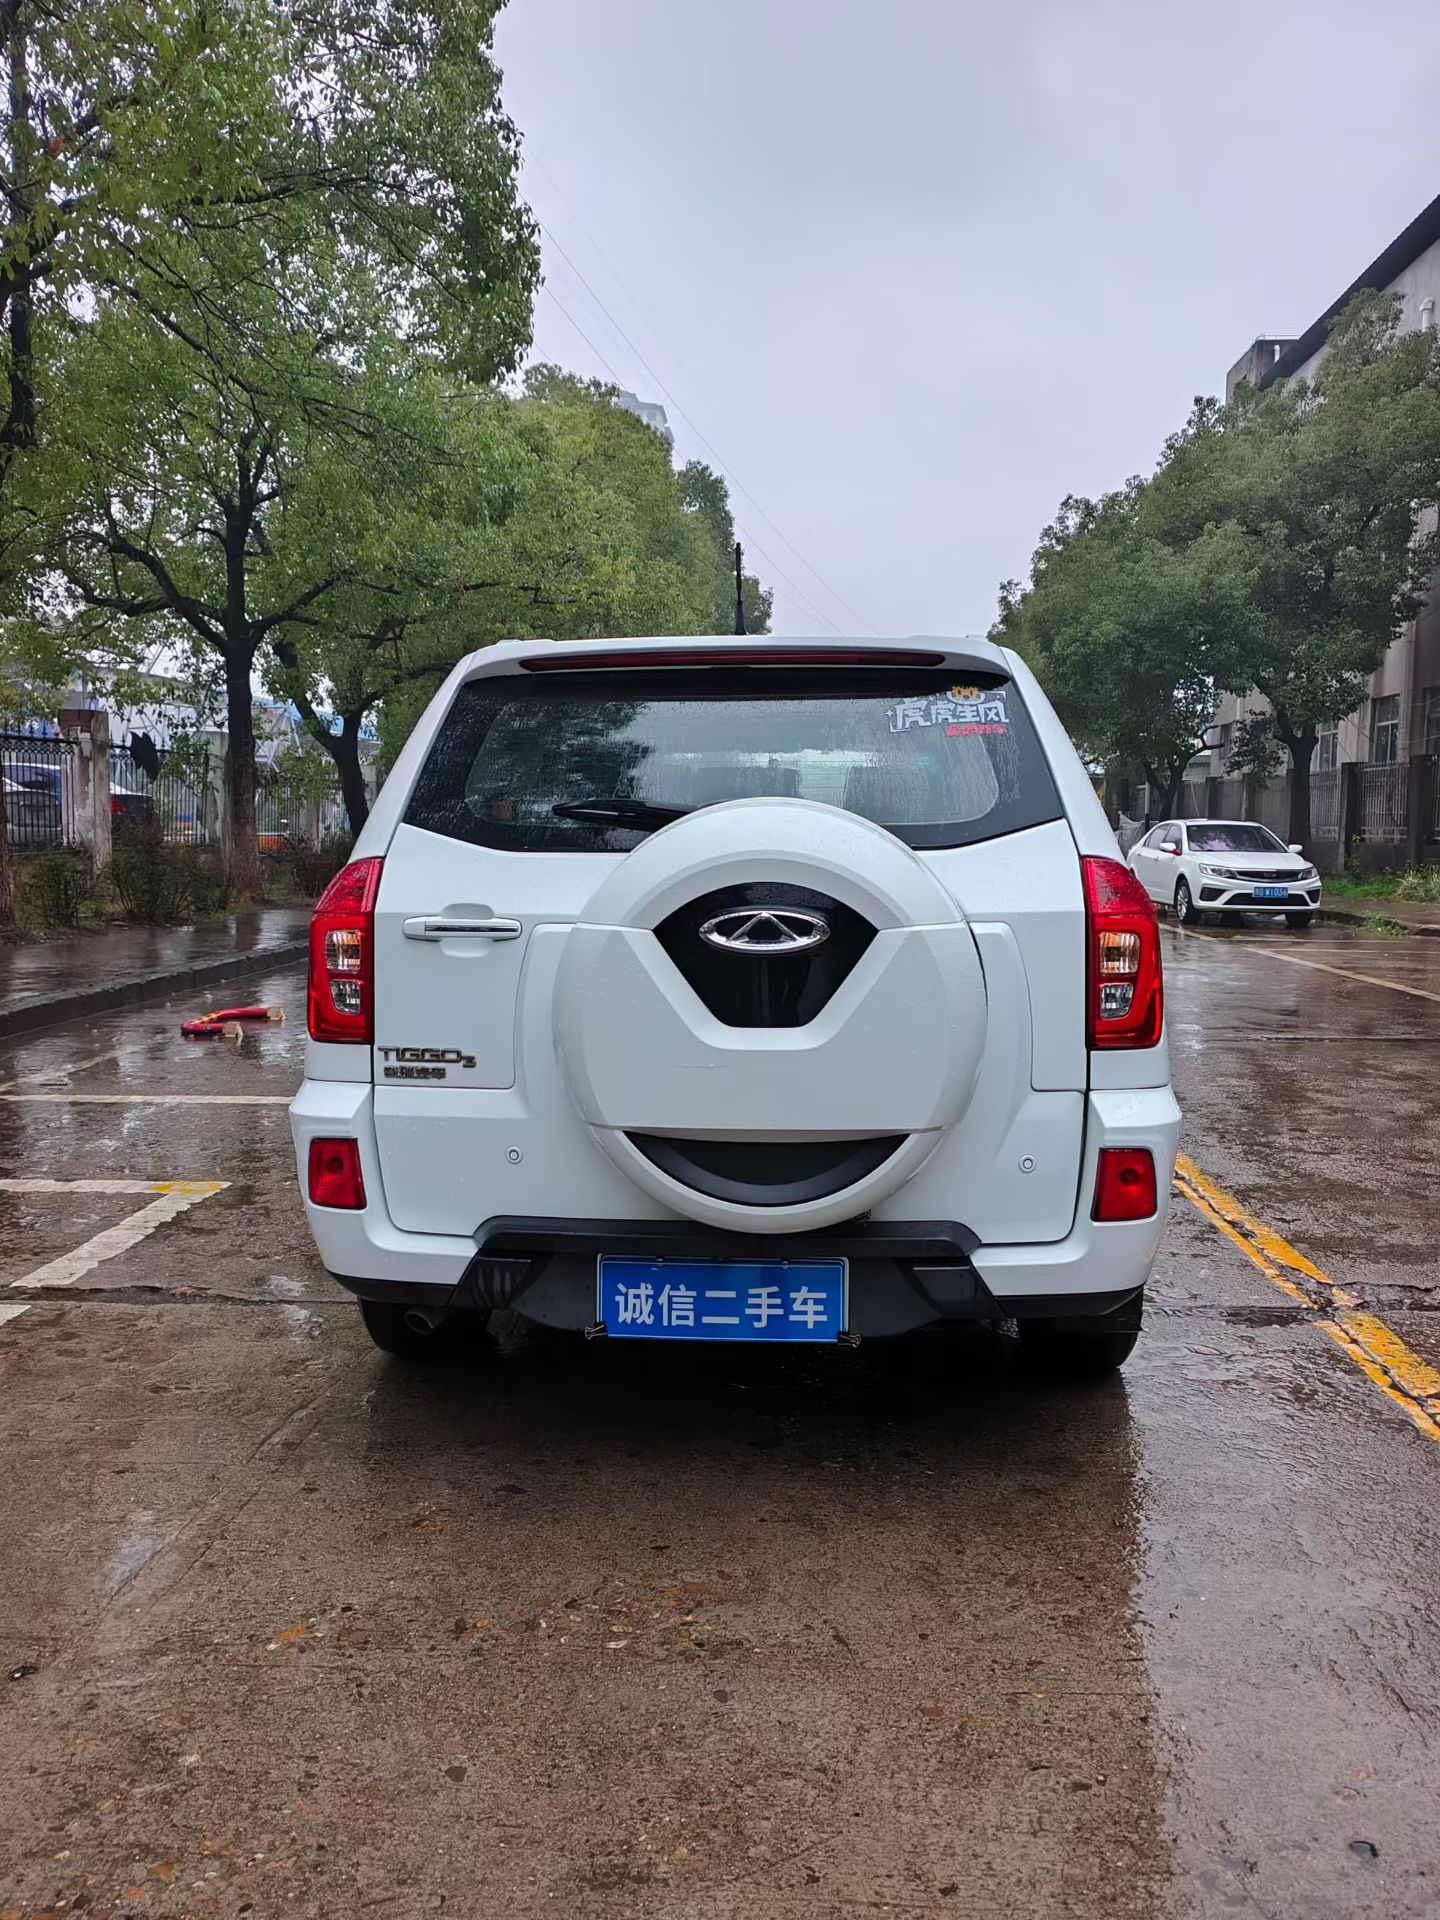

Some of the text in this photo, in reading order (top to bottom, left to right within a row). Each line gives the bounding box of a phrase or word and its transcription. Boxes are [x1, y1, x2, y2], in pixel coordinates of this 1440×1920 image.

[893, 698, 1009, 730] 虎虎生风
[615, 1282, 828, 1329] 诚信二手车
